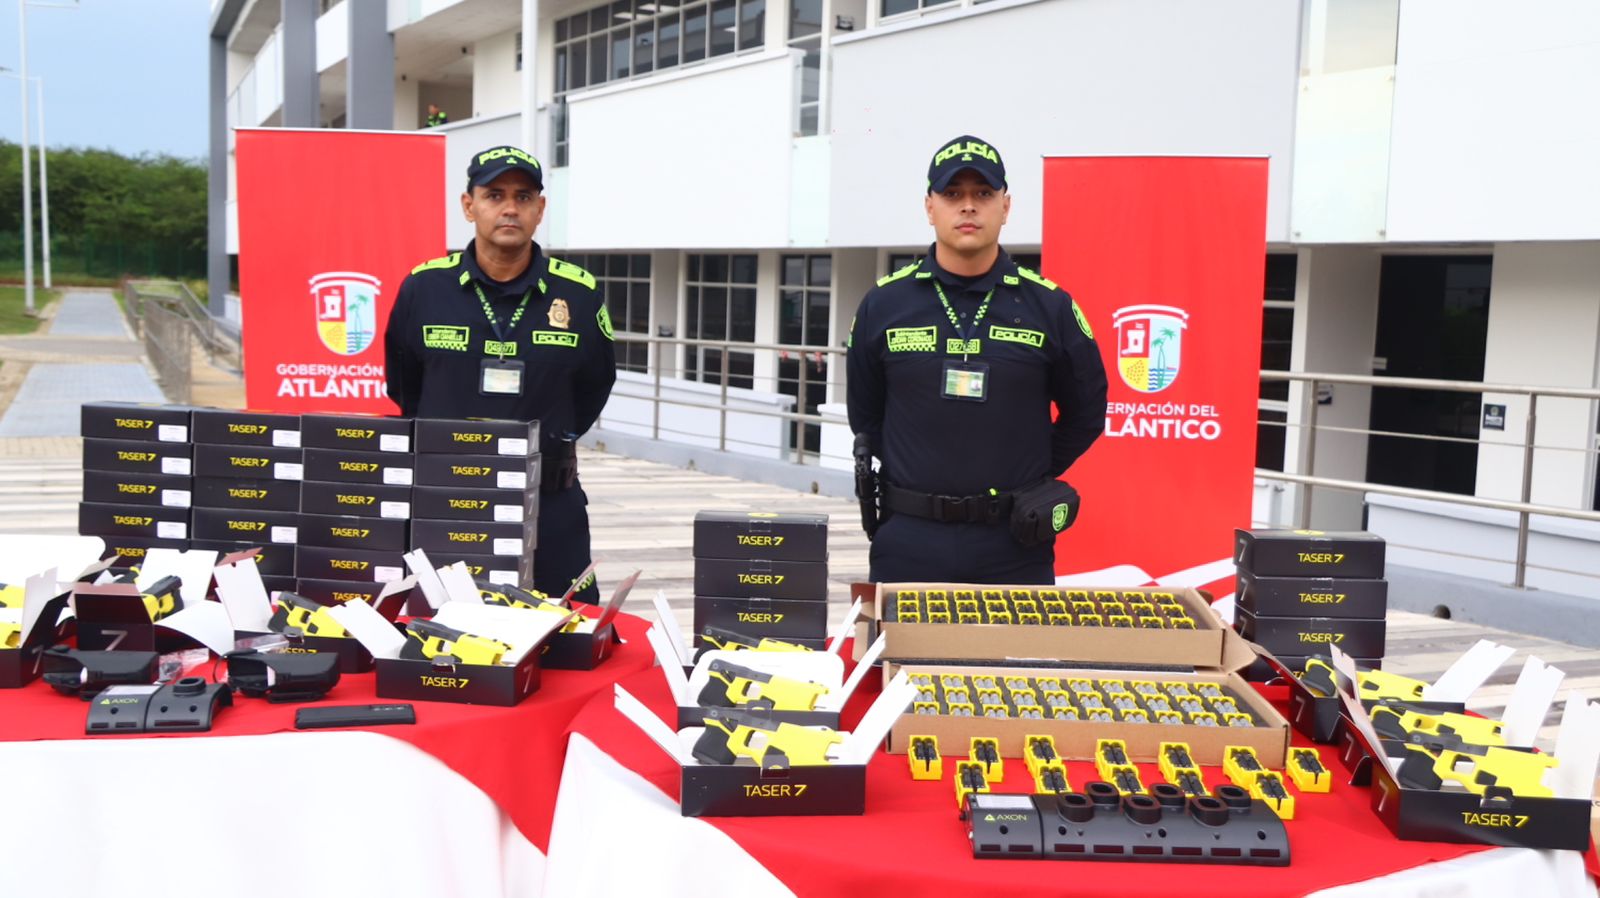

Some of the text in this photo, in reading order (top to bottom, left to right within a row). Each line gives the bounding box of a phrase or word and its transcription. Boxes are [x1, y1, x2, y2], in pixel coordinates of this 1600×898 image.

[935, 141, 998, 166] POLICÍA
[276, 363, 384, 377] GOBERNACIÓN
[277, 374, 389, 398] ATLÁNTI
[1106, 401, 1219, 417] ERNACIÓN DEL
[115, 418, 155, 429] TASER 7
[229, 424, 268, 434] TASER 7
[1105, 413, 1222, 441] LÁNTICO
[335, 428, 376, 439] TASER 7
[452, 432, 494, 445] TASER 7
[118, 451, 157, 462] TASER 7
[229, 457, 271, 467] TASER 7
[340, 461, 380, 472] TASER 7
[451, 466, 492, 476] TASER 7
[119, 483, 157, 495] TASER 7
[228, 488, 268, 500] TASER 7
[336, 495, 376, 506] TASER 7
[448, 499, 490, 510] TASER 7
[113, 515, 154, 527] TASER 7
[227, 521, 268, 532] TASER 7
[331, 527, 370, 538] TASER 7
[447, 532, 489, 543] TASER 7
[737, 535, 785, 546] TASER 7
[114, 547, 145, 557] TASER
[1296, 553, 1345, 564] TASER 7
[330, 559, 369, 571] TASER 7
[739, 574, 785, 585] TASER 7
[1299, 592, 1346, 604] TASER 7
[737, 612, 785, 624] TASER 7
[1298, 633, 1345, 644] TASER 7
[421, 675, 470, 689] TASER 7
[744, 784, 809, 797] TASER 7
[1463, 811, 1531, 829] TASER 7
